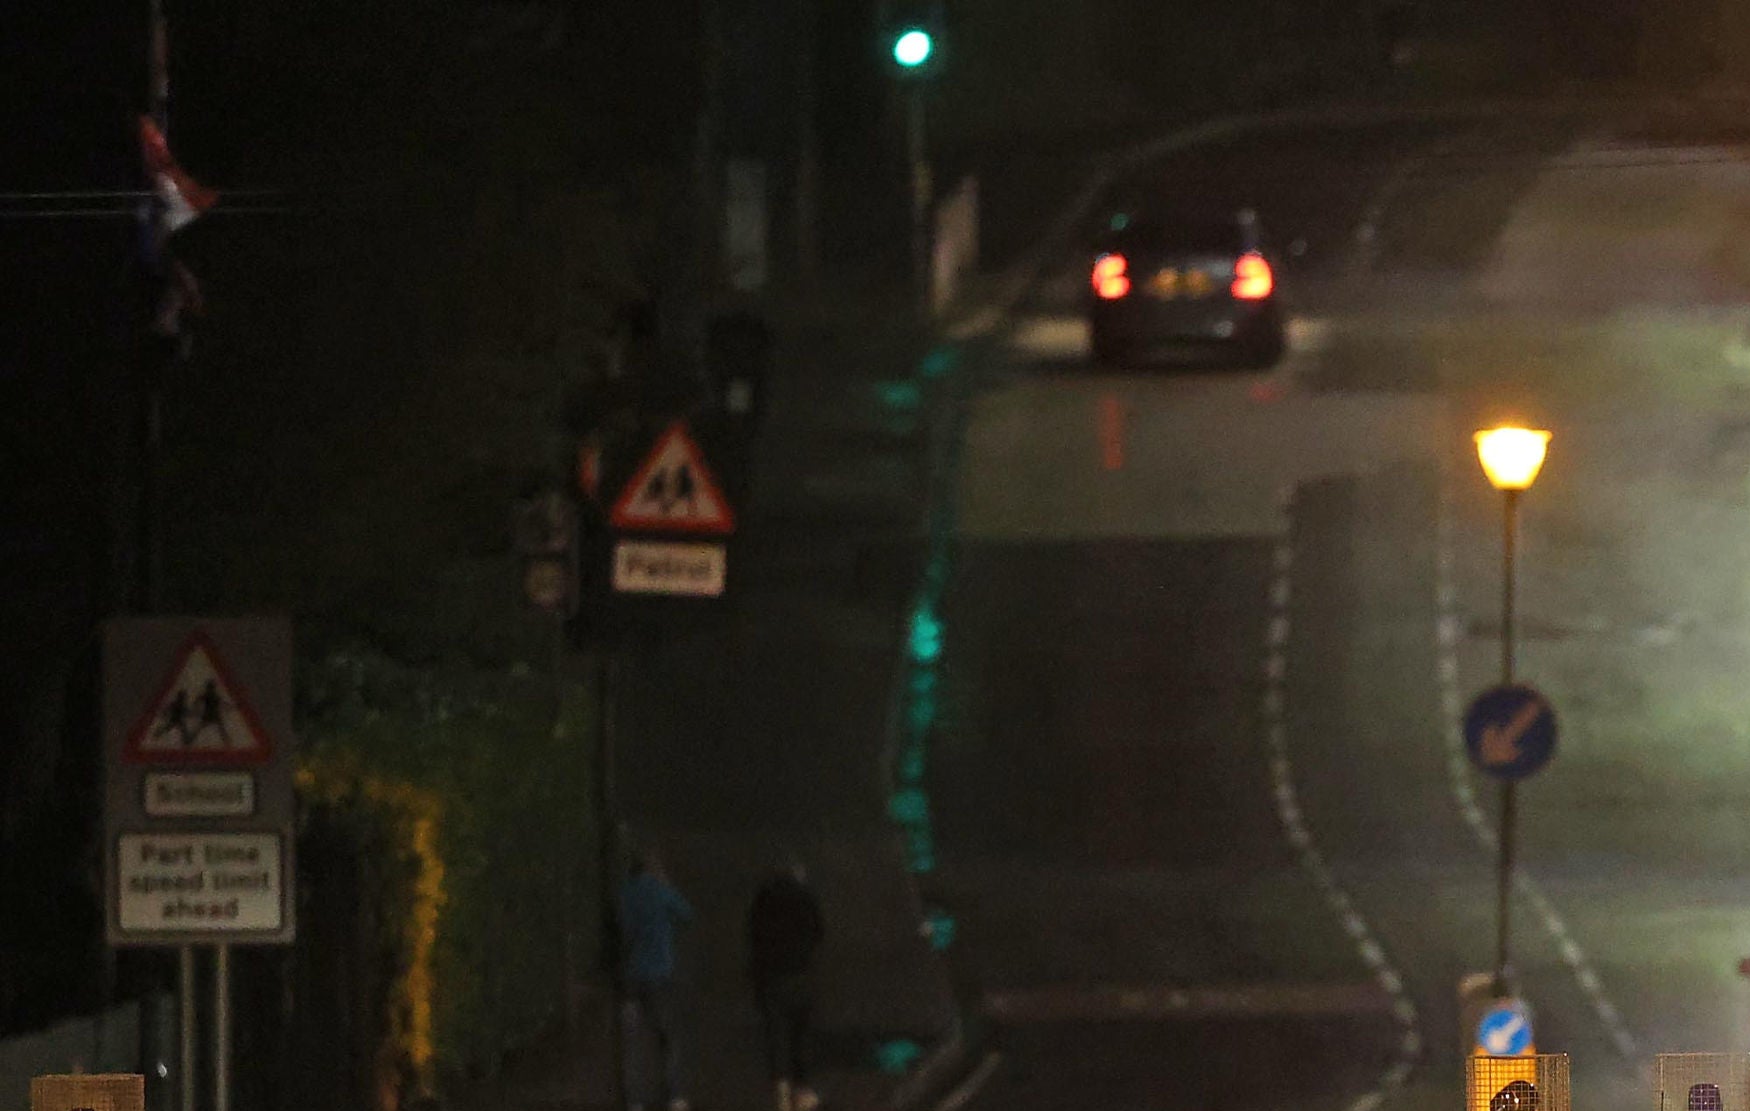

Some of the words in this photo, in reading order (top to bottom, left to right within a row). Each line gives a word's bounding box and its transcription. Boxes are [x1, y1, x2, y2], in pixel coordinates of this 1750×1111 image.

[140, 843, 193, 865] Part
[204, 843, 260, 863] time
[129, 871, 204, 894] speed
[213, 871, 270, 891] limit
[162, 897, 240, 918] ahead
